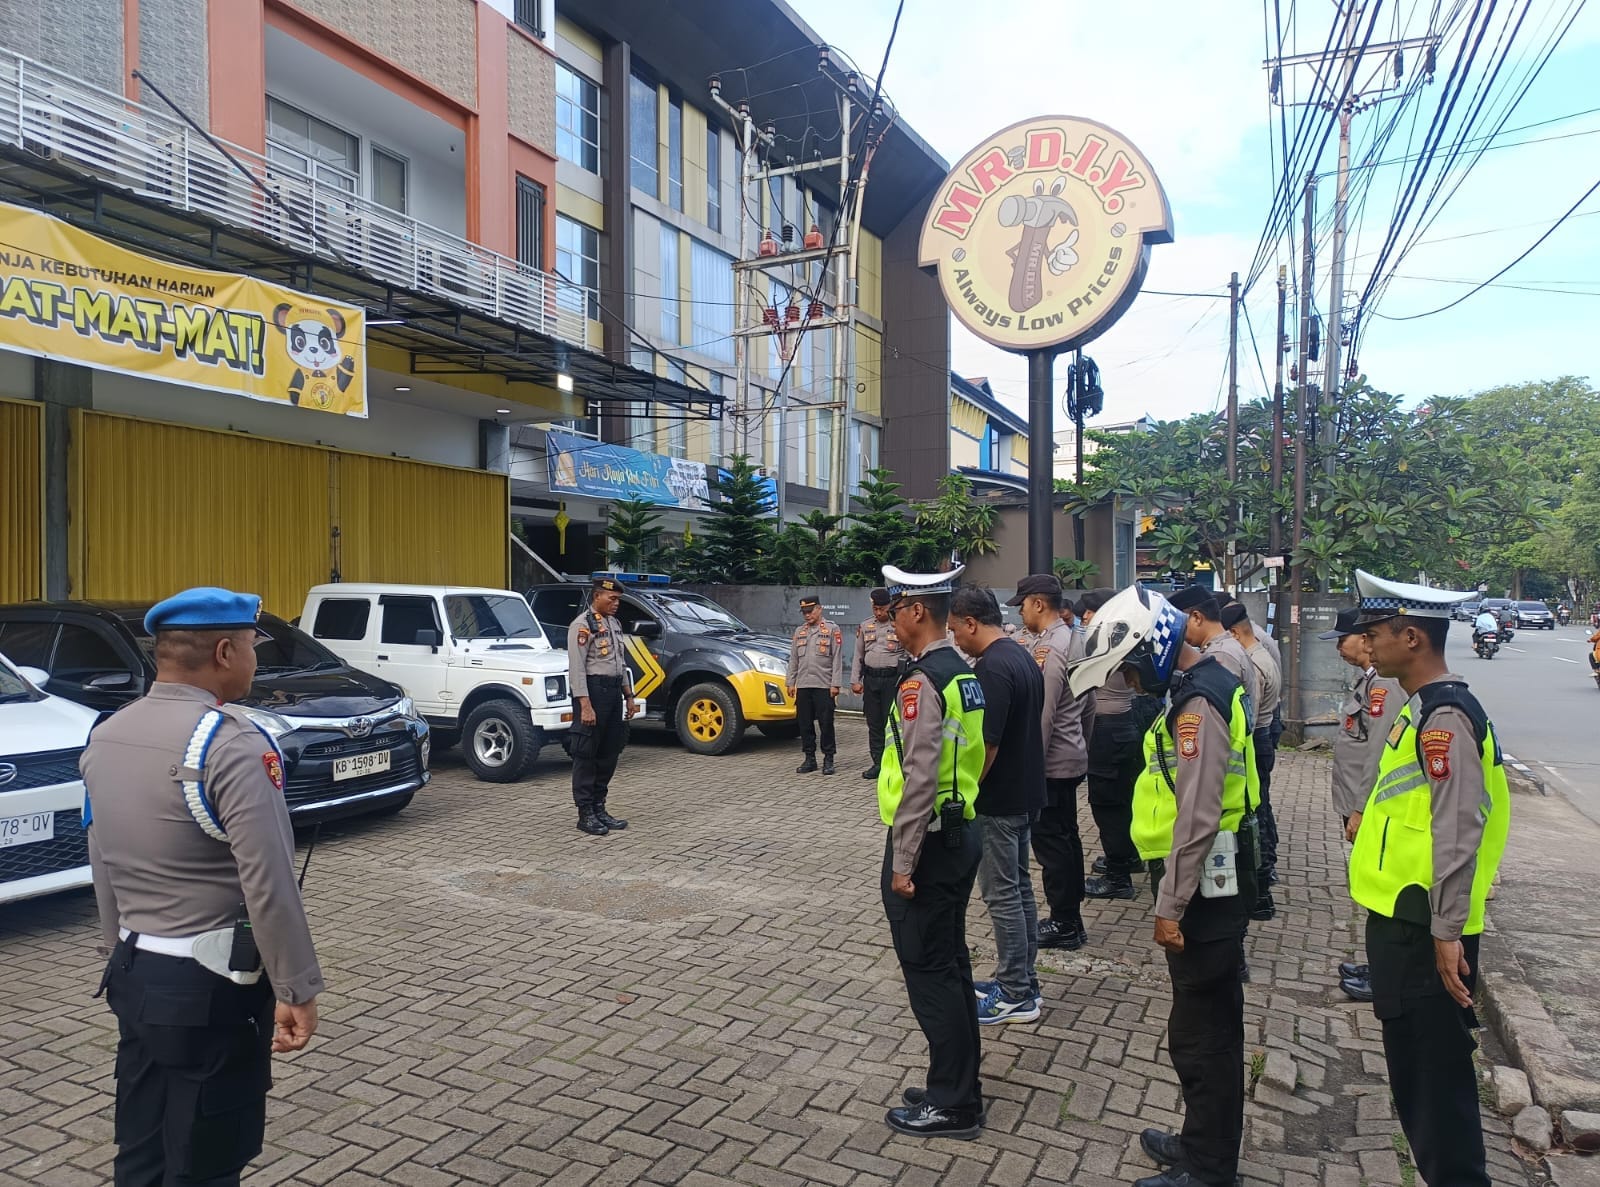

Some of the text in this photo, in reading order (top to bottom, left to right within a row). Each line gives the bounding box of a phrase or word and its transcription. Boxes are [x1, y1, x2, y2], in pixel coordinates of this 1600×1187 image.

[40, 258, 153, 289] KEBUTUHAN
[156, 278, 216, 298] HARIAN
[953, 246, 1122, 331] Always Low Prices
[580, 461, 600, 481] Hari
[335, 760, 348, 774] KB
[351, 755, 374, 771] 1598
[378, 752, 389, 765] DV
